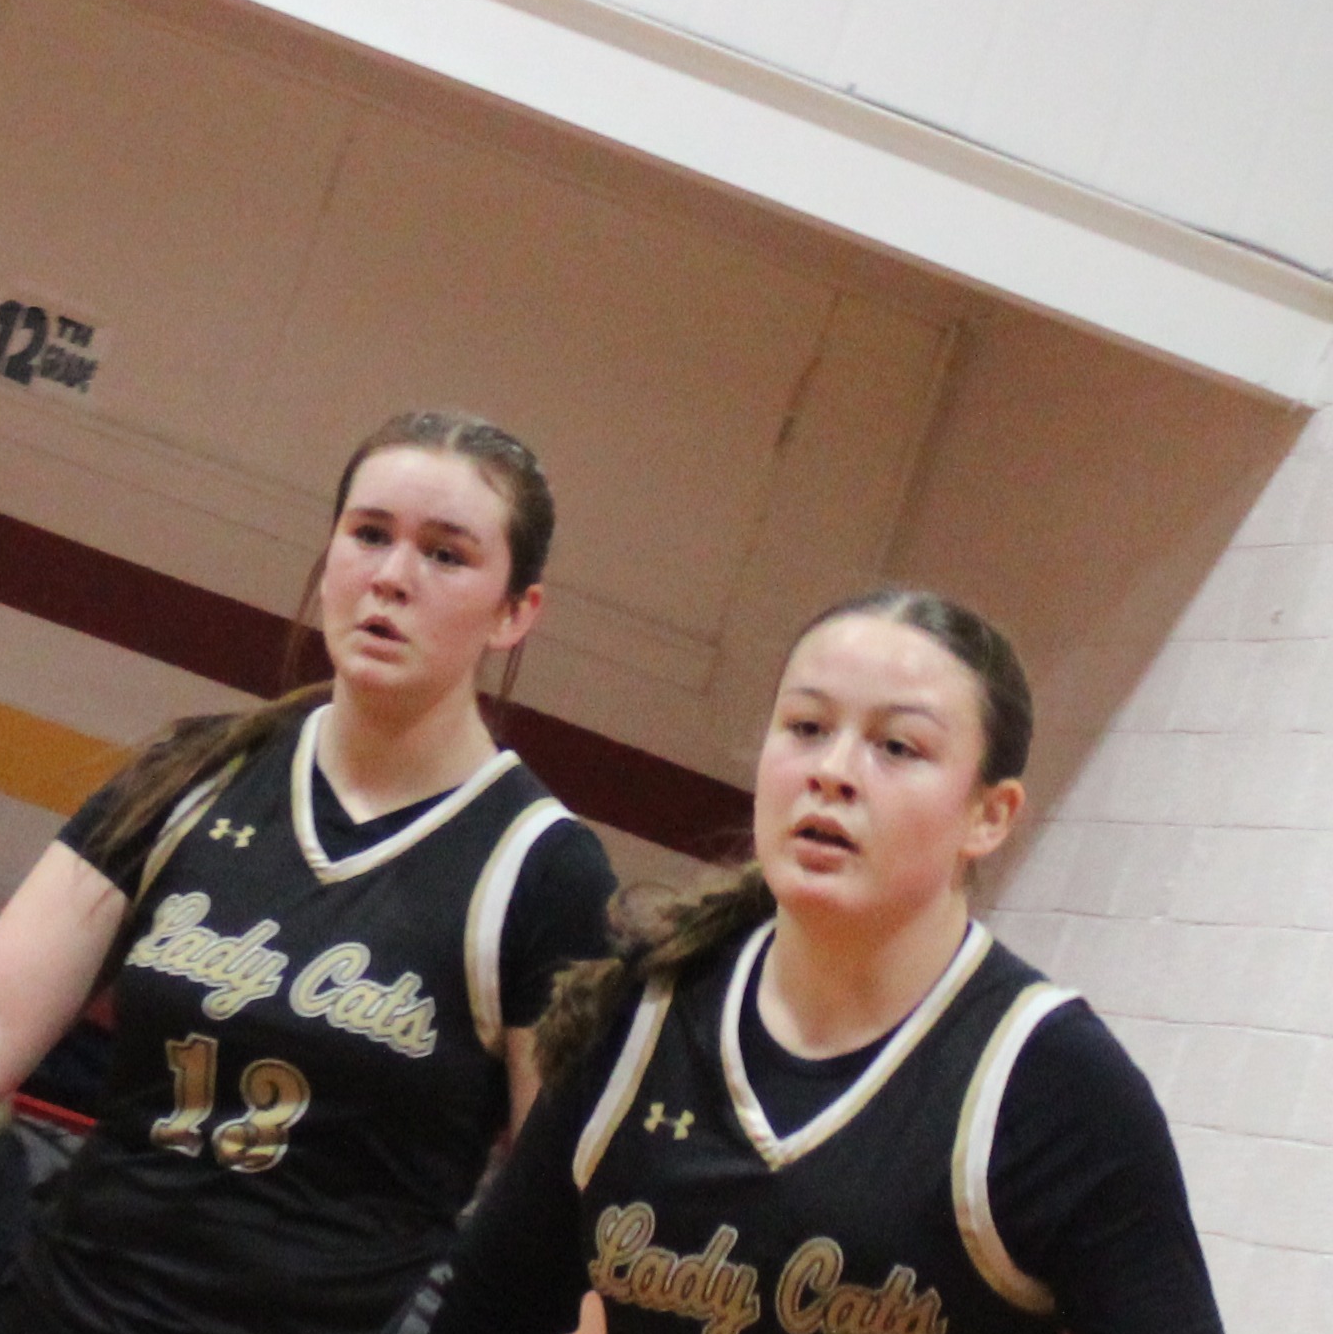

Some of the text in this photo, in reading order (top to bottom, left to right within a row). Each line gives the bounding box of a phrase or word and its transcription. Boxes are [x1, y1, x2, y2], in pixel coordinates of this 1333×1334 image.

[124, 891, 438, 1058] Lady Cats
[150, 1033, 311, 1174] 12
